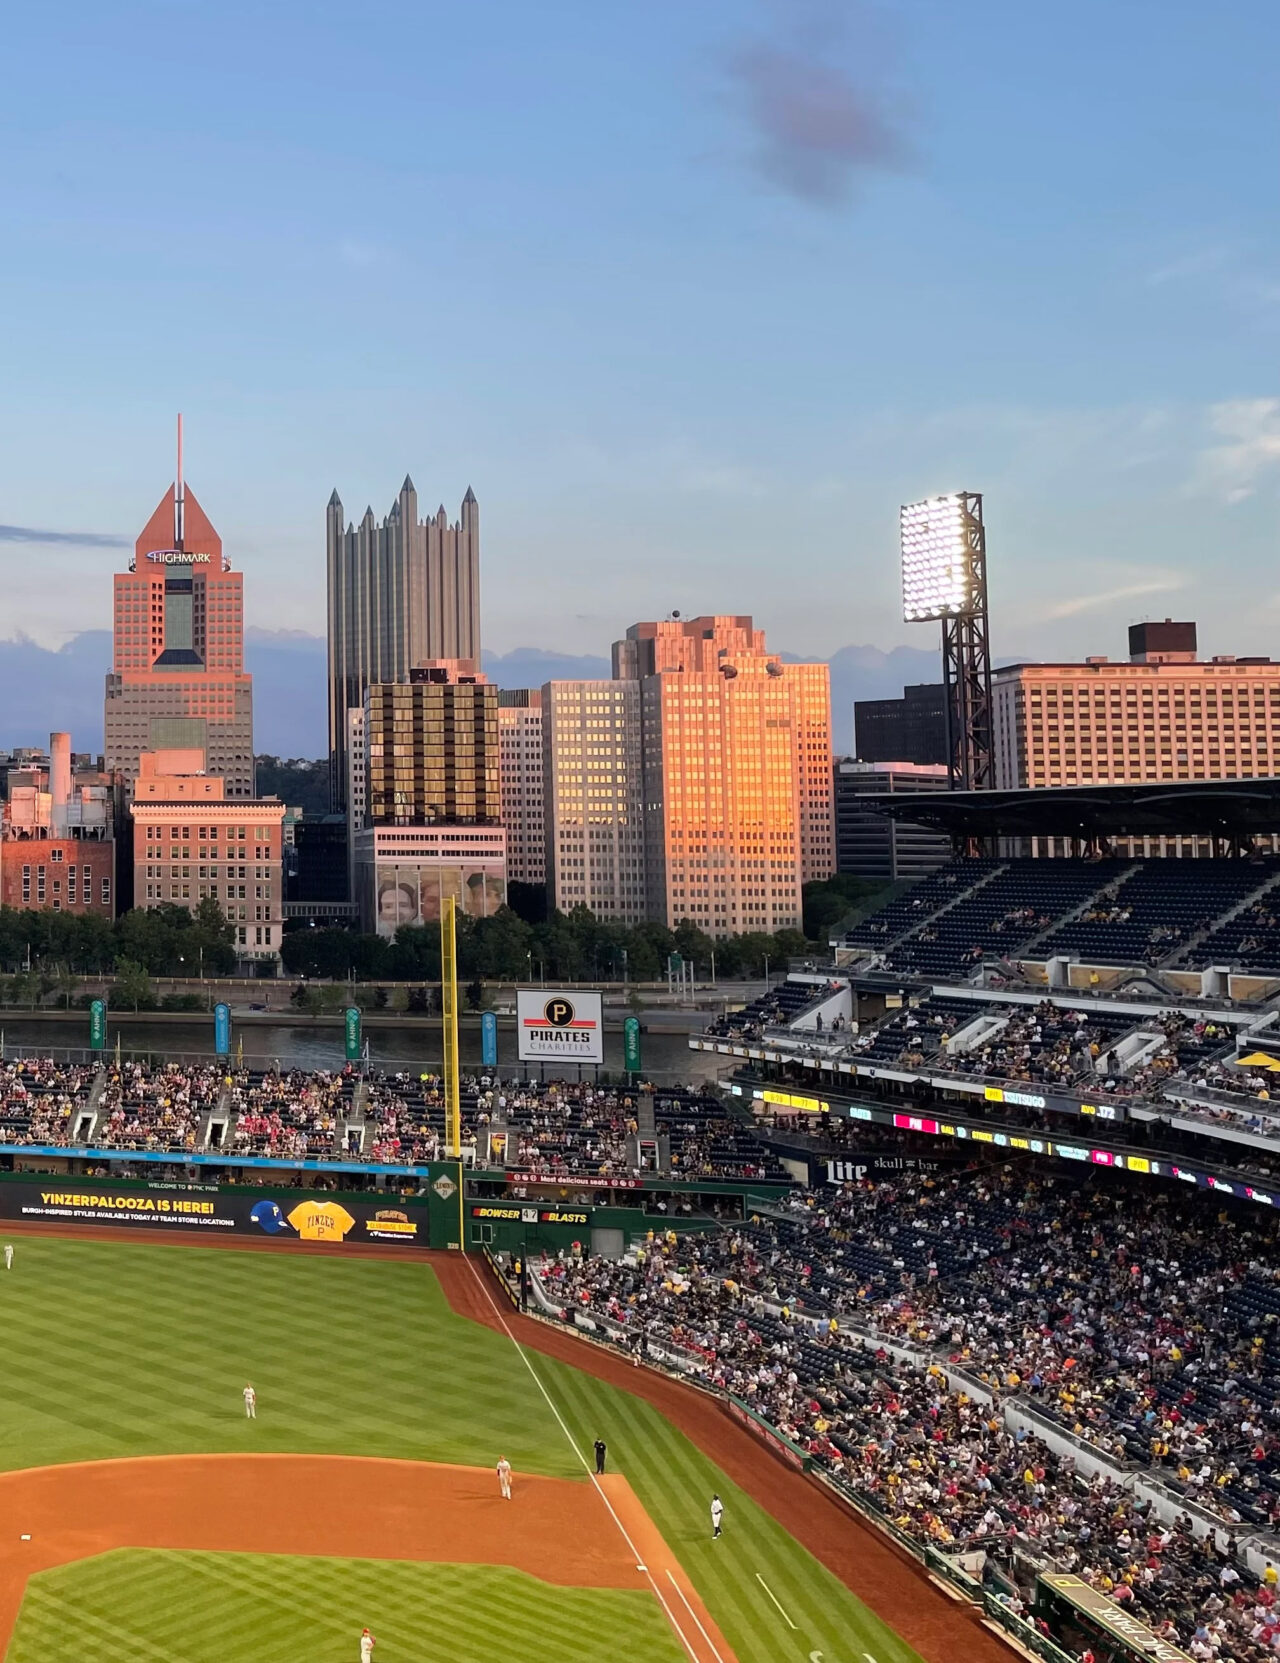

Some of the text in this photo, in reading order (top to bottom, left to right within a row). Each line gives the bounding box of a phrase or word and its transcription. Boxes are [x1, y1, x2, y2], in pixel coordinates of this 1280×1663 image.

[153, 553, 211, 563] HIGHMARK
[553, 1004, 567, 1022] P
[530, 1030, 590, 1043] PIRATES
[628, 1031, 636, 1051] AHN
[530, 1042, 591, 1052] CHARITIES
[874, 1157, 939, 1170] skull bar
[826, 1160, 867, 1184] Lite
[558, 1176, 589, 1185] delicious
[590, 1178, 608, 1186] seats
[41, 1192, 214, 1214] YINZERPALOOZA IS HERE!
[22, 1207, 73, 1216] BURGH-INSPIRED
[73, 1209, 96, 1217] STYLES
[96, 1211, 130, 1220] AVAILABLE
[199, 1218, 235, 1226] LOCATIONS
[272, 1206, 280, 1217] P
[480, 1208, 520, 1219] BOWSER
[548, 1212, 587, 1223] BLASTS
[307, 1214, 335, 1230] YINZER
[317, 1227, 325, 1238] P
[1093, 1607, 1146, 1635] PARK
